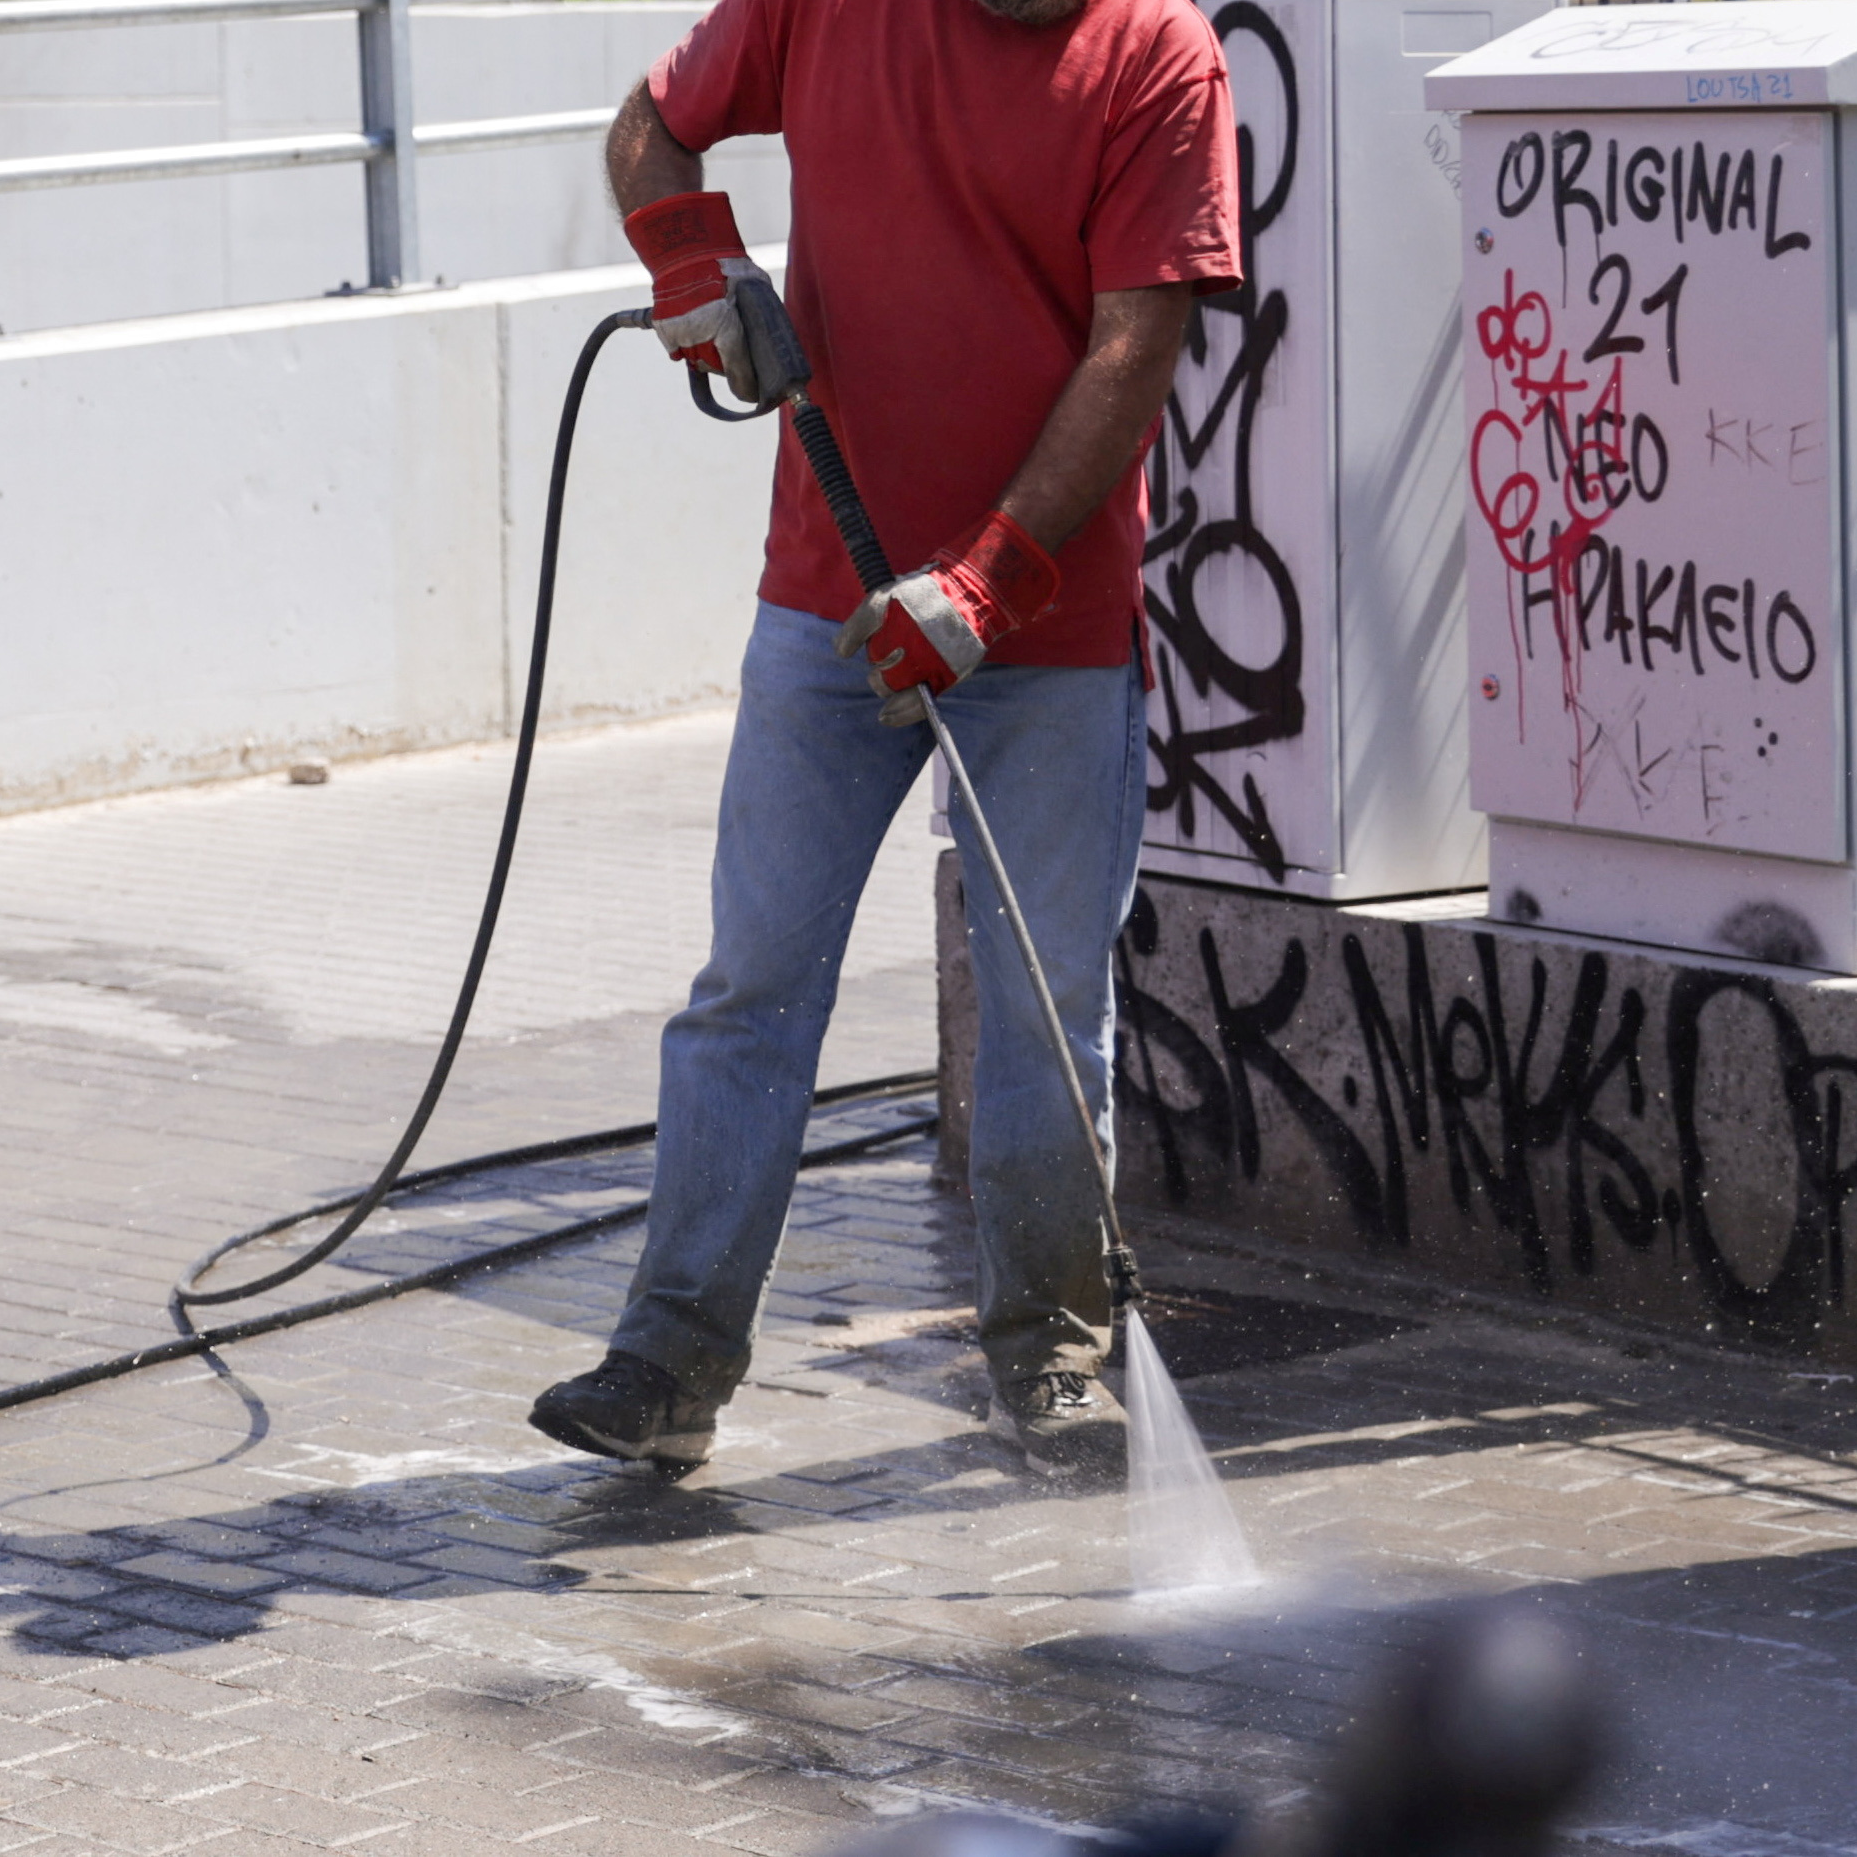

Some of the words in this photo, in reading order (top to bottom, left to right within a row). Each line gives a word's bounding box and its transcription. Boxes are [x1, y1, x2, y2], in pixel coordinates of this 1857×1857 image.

[1766, 74, 1794, 98] 21
[1497, 130, 1811, 257] ORIGINAL
[1584, 253, 1689, 385] 21
